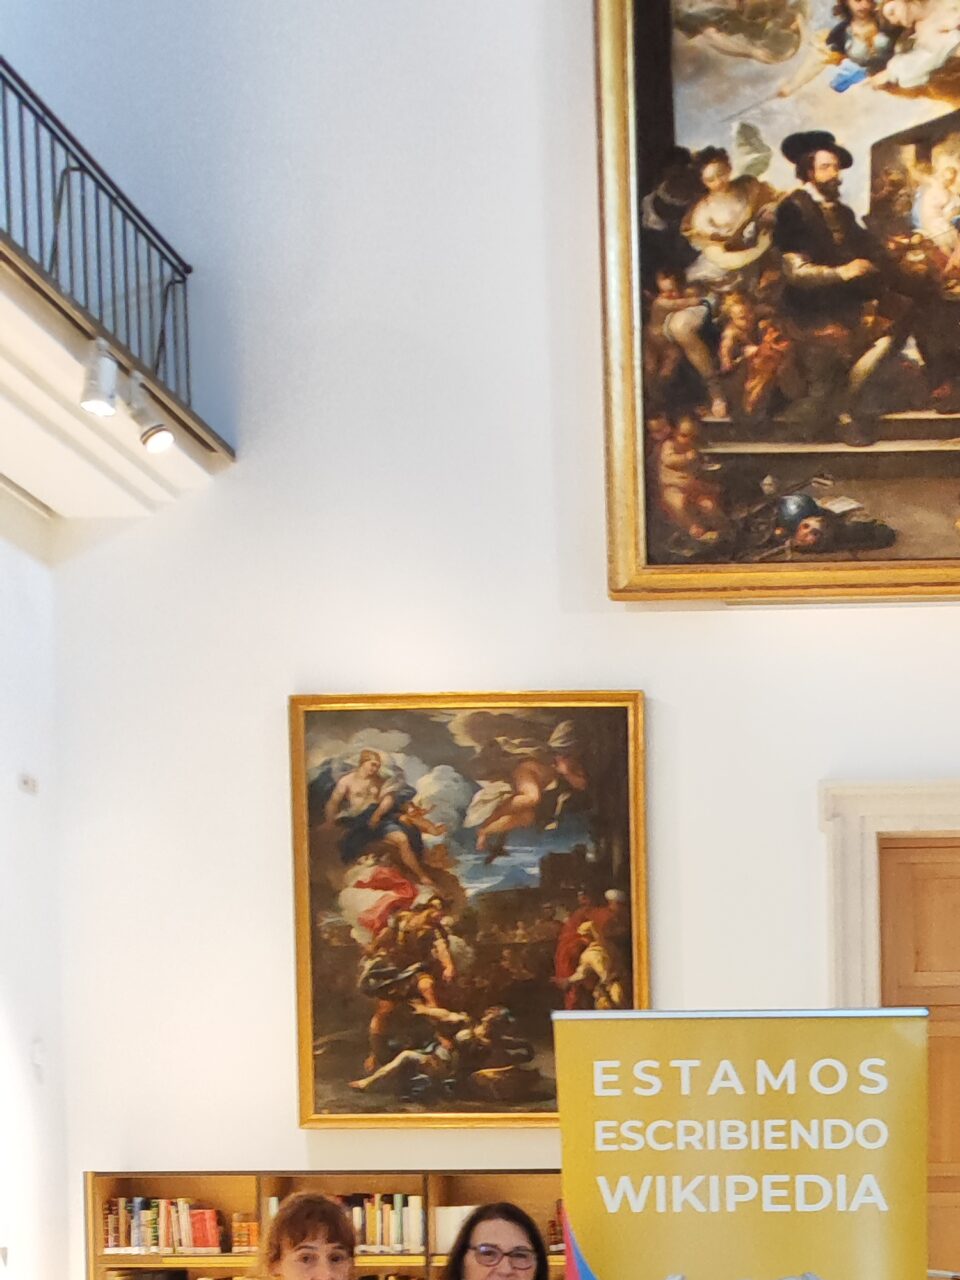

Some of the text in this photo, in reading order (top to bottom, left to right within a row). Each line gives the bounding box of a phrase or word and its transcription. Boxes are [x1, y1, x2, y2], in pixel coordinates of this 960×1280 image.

[593, 1058, 889, 1097] ESTAMOS
[594, 1118, 889, 1152] ESCRIBIENDO
[596, 1173, 889, 1213] WIKIPEDIA
